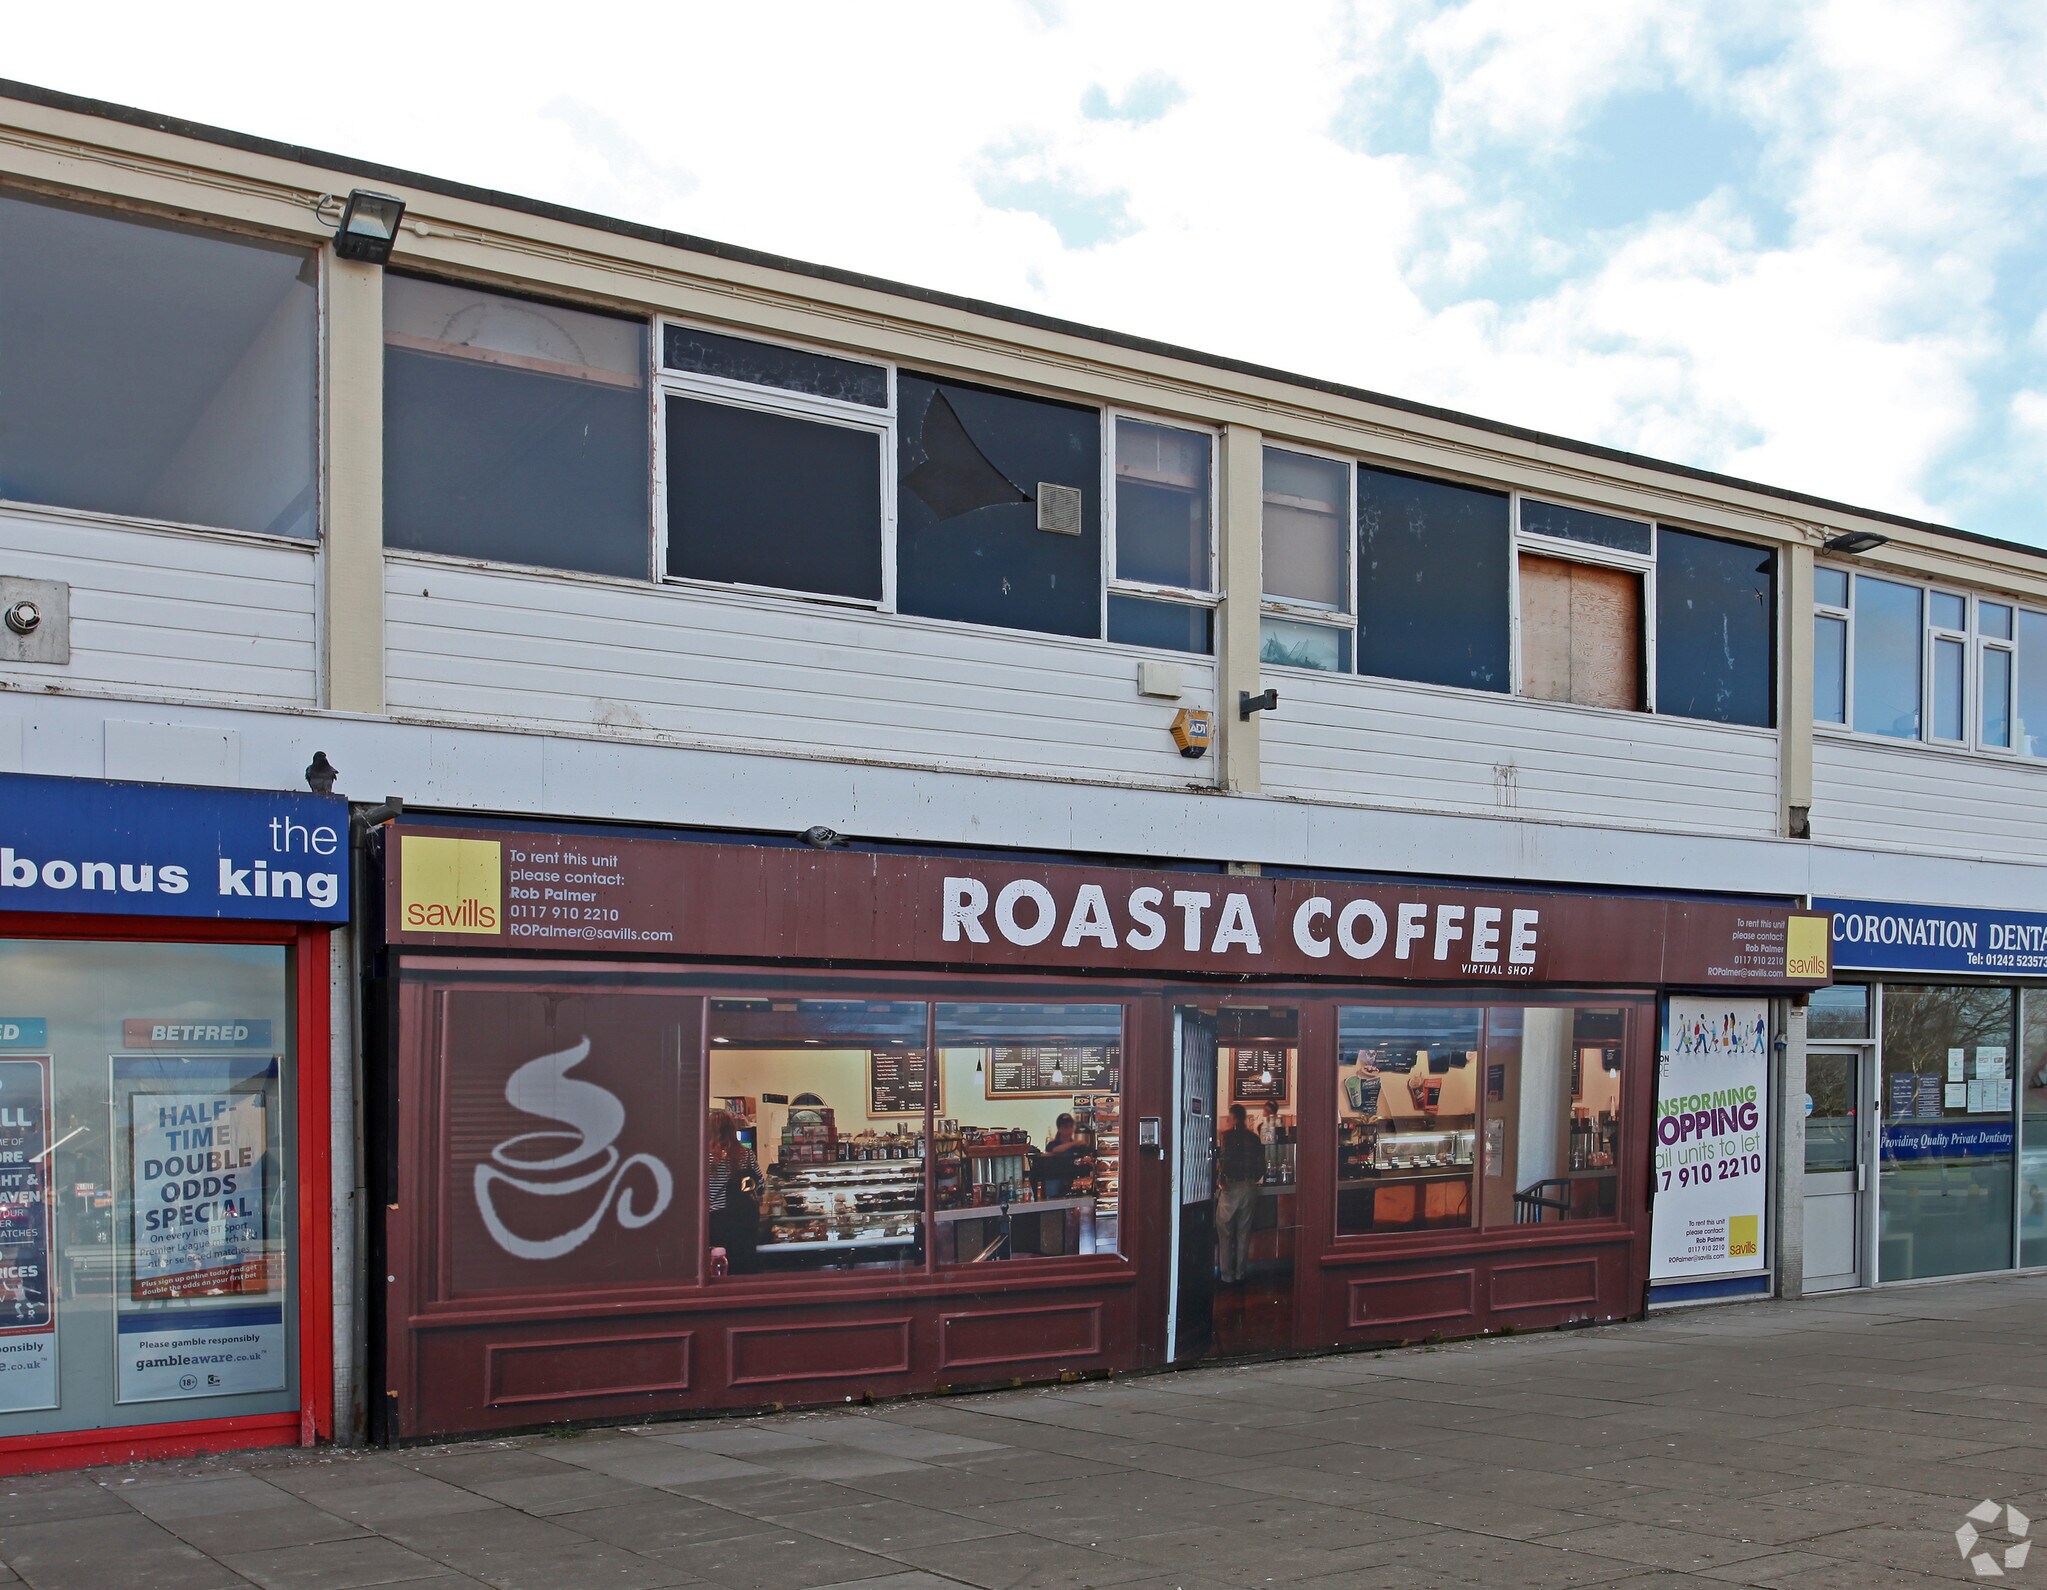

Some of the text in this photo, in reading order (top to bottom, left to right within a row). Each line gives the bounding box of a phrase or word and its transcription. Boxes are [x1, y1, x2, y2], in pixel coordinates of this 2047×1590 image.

[269, 816, 338, 854] the
[510, 850, 618, 867] To rent this unit
[0, 848, 338, 908] bonus king
[510, 869, 624, 886] please contact:
[510, 886, 596, 902] Rob Palmer
[407, 899, 496, 928] savills
[510, 905, 619, 921] 0117 910 2210
[942, 876, 1539, 964] ROASTA COFFEE
[1760, 920, 1771, 928] this
[1833, 912, 1977, 948] CORONATION
[510, 924, 673, 942] ROPalmer@savills.com
[1732, 931, 1755, 940] please
[1760, 944, 1784, 952] Palmer
[1734, 956, 1784, 965] 0117 910 2210
[1789, 956, 1824, 974] savills
[1967, 952, 1983, 965] Tel:
[1986, 954, 2014, 966] 01242
[1461, 964, 1534, 975] VIRTUAL SHOP
[1708, 967, 1783, 978] ROPalmer@savills.com
[152, 1026, 248, 1041] BETFRED
[160, 1100, 236, 1127] HALF-
[11, 1138, 24, 1146] OF
[166, 1125, 230, 1151] TIME
[1880, 1132, 2013, 1149] Providing Quality Private Dentistry
[1678, 1142, 1714, 1165] units
[1719, 1138, 1736, 1156] to
[1741, 1132, 1760, 1153] let
[144, 1147, 252, 1180] DOUBLE
[1679, 1163, 1712, 1188] 910
[1718, 1154, 1760, 1180] 2210
[26, 1174, 38, 1186] &
[161, 1174, 237, 1203] ODDS
[145, 1197, 252, 1231] SPECIAL
[150, 1234, 164, 1243] On
[166, 1231, 191, 1241] every
[193, 1227, 208, 1236] live
[224, 1222, 248, 1233] Sport
[140, 1246, 174, 1256] Premier
[178, 1240, 210, 1252] League
[214, 1246, 250, 1257] matches
[1730, 1241, 1756, 1255] savills
[143, 1287, 167, 1296] double
[172, 1338, 206, 1348] gamble
[208, 1334, 260, 1345] responsibly
[136, 1352, 261, 1371] gambleaware.co.uk
